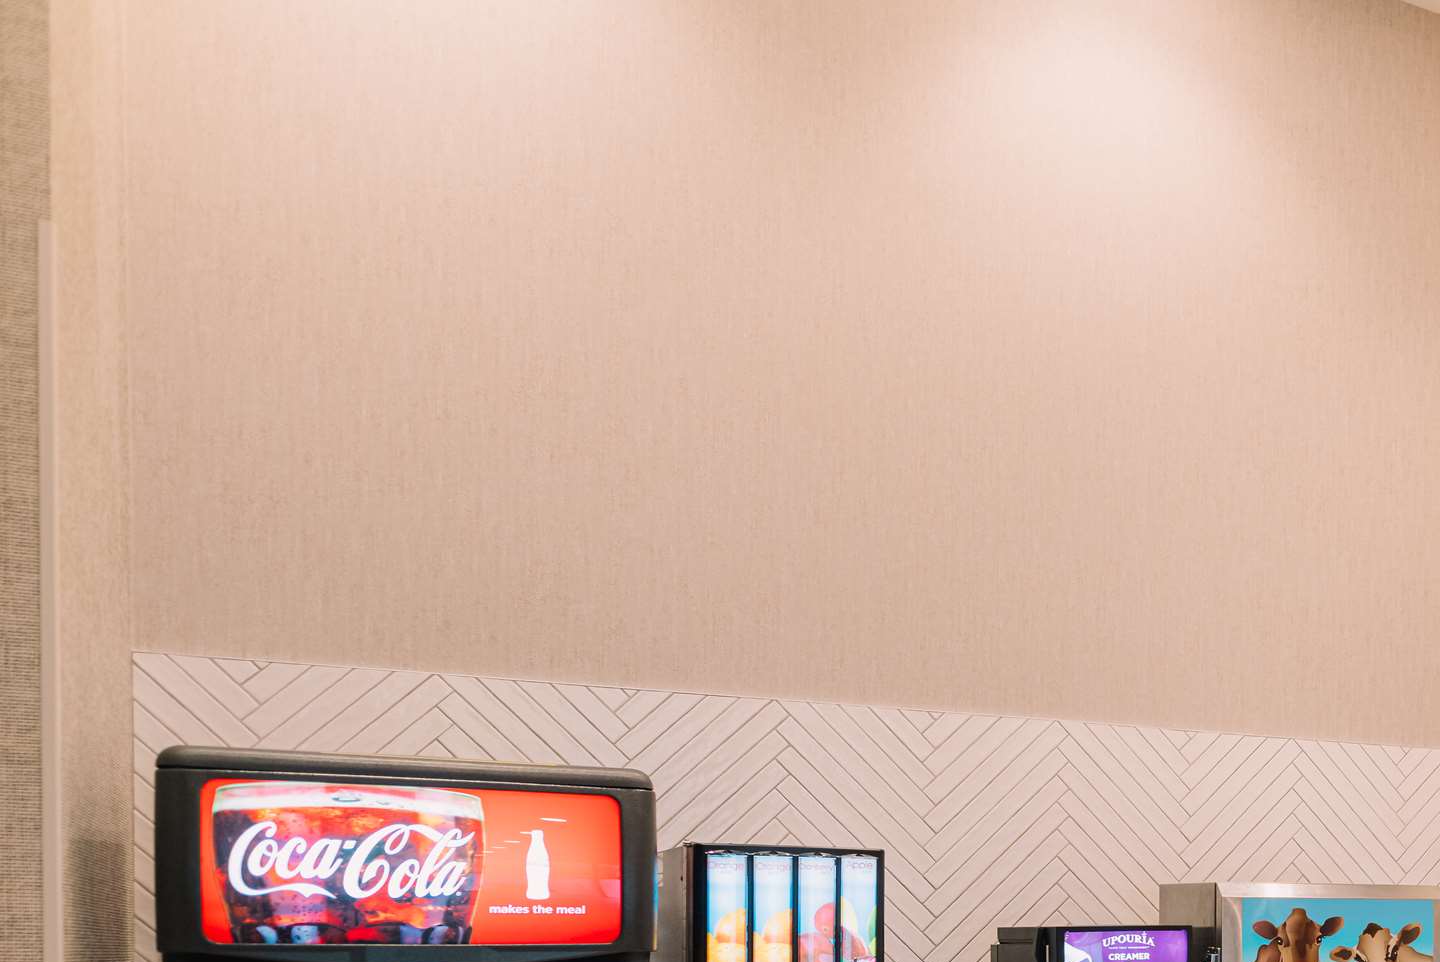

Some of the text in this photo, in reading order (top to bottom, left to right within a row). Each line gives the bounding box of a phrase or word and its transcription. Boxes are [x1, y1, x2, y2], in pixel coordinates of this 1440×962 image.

[228, 821, 476, 899] Coca-Cola
[489, 904, 586, 915] makes the meal
[1108, 952, 1151, 961] CREAMER
